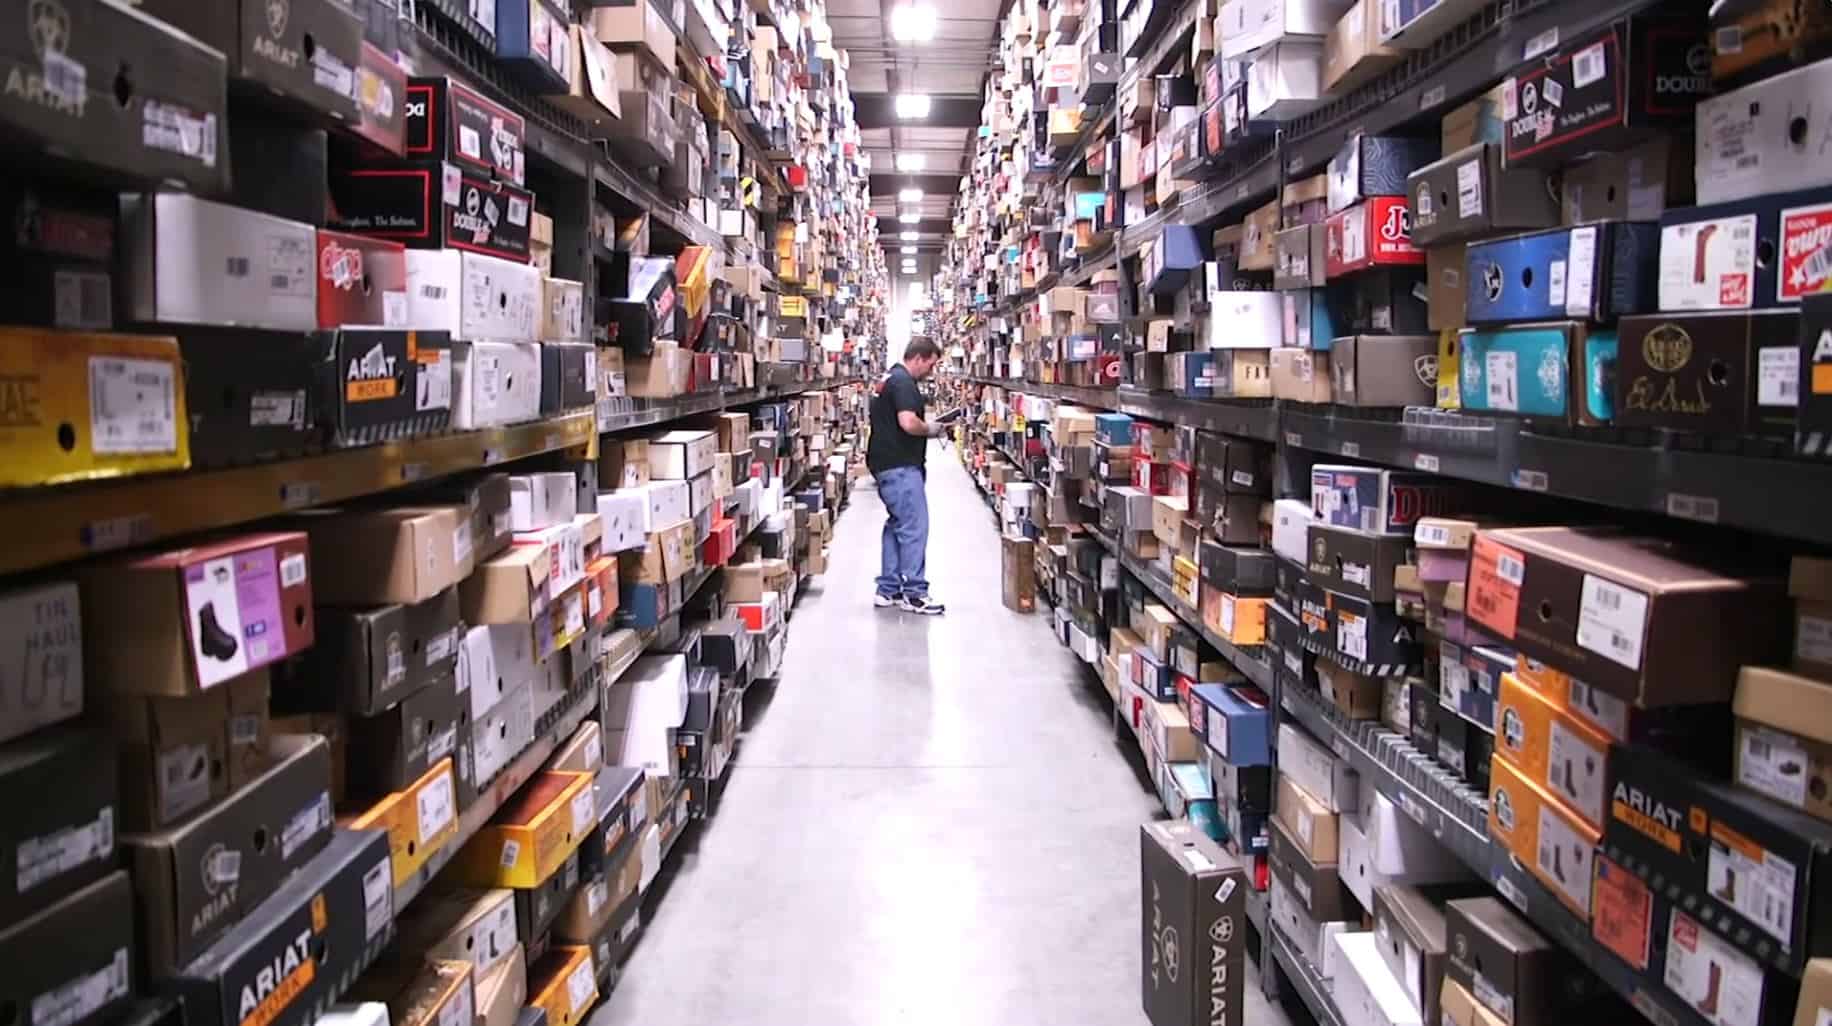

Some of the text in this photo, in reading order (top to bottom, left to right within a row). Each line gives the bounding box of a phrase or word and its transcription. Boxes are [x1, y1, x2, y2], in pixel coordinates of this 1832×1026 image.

[253, 36, 298, 68] ARIAT
[26, 622, 79, 651] HAUL
[34, 599, 68, 625] TIN
[1613, 781, 1683, 831] ARIAT
[191, 884, 238, 935] ARIAT
[239, 928, 311, 1021] ARIAT
[1210, 944, 1227, 1026] ARIAT
